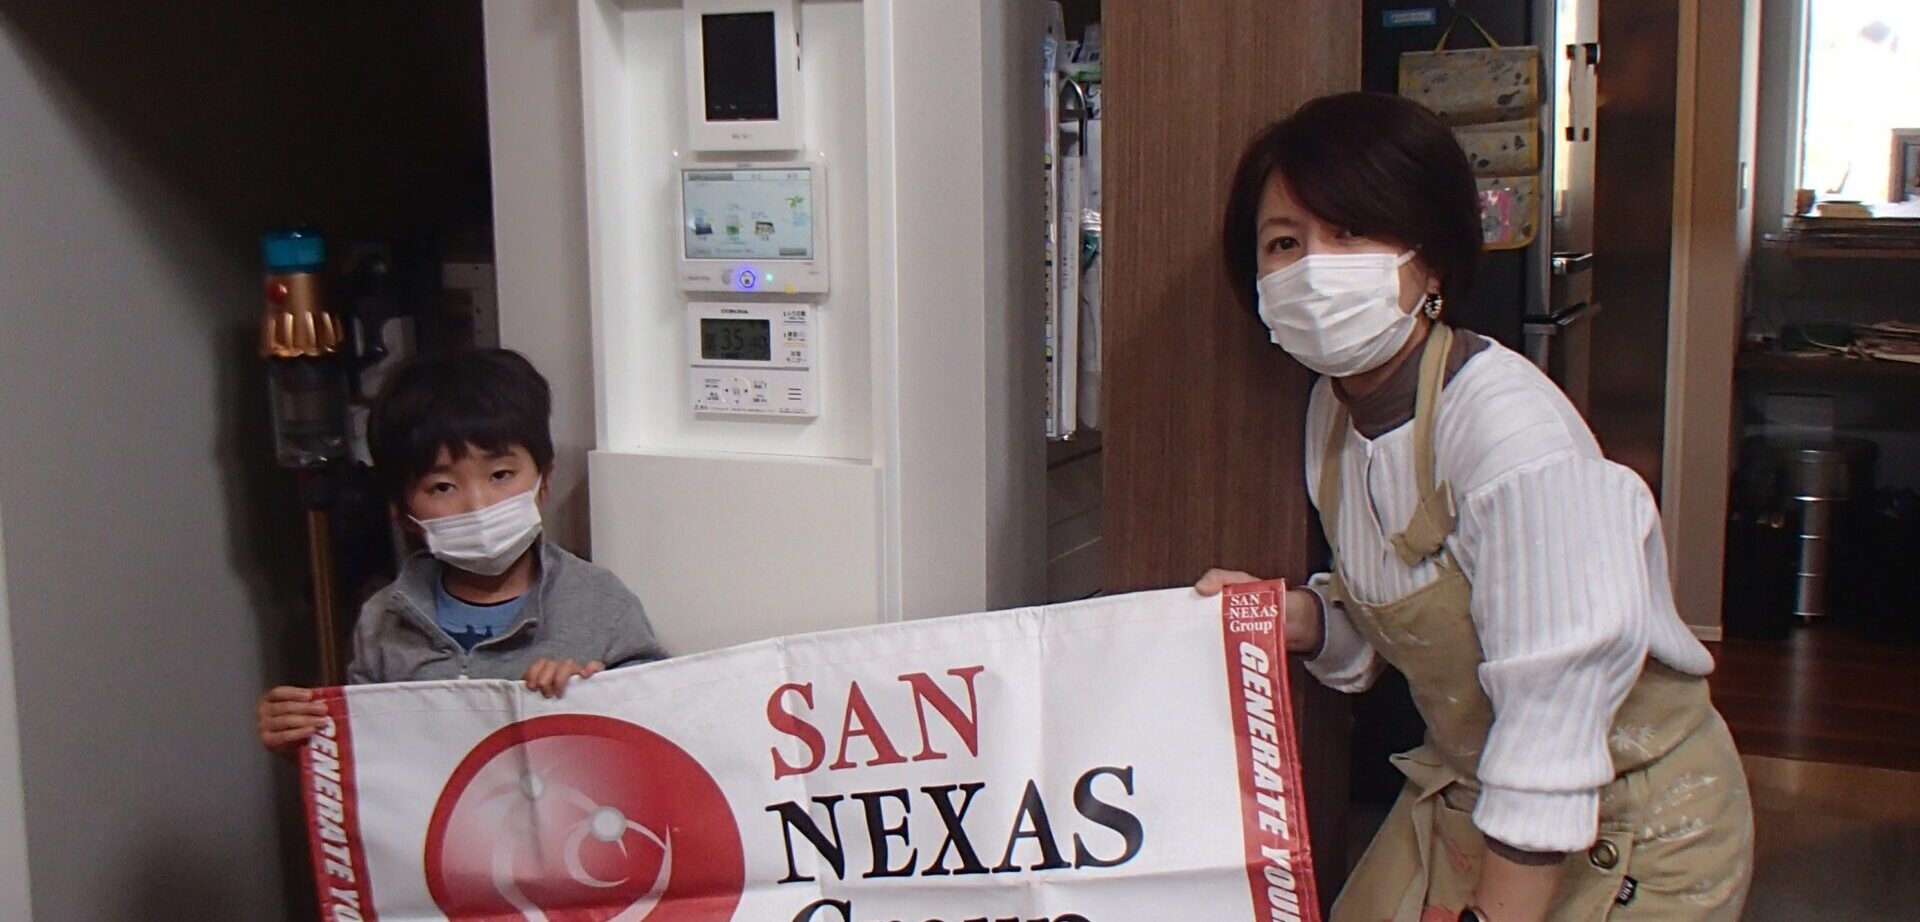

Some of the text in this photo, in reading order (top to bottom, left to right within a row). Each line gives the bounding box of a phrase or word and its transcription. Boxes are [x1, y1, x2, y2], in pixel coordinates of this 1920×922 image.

[1229, 604, 1278, 619] NEXAS
[1230, 593, 1260, 606] SAN
[1230, 620, 1273, 634] Group
[766, 665, 985, 780] SAN
[1239, 641, 1290, 841] GENERATE
[765, 766, 1144, 884] NEXAS
